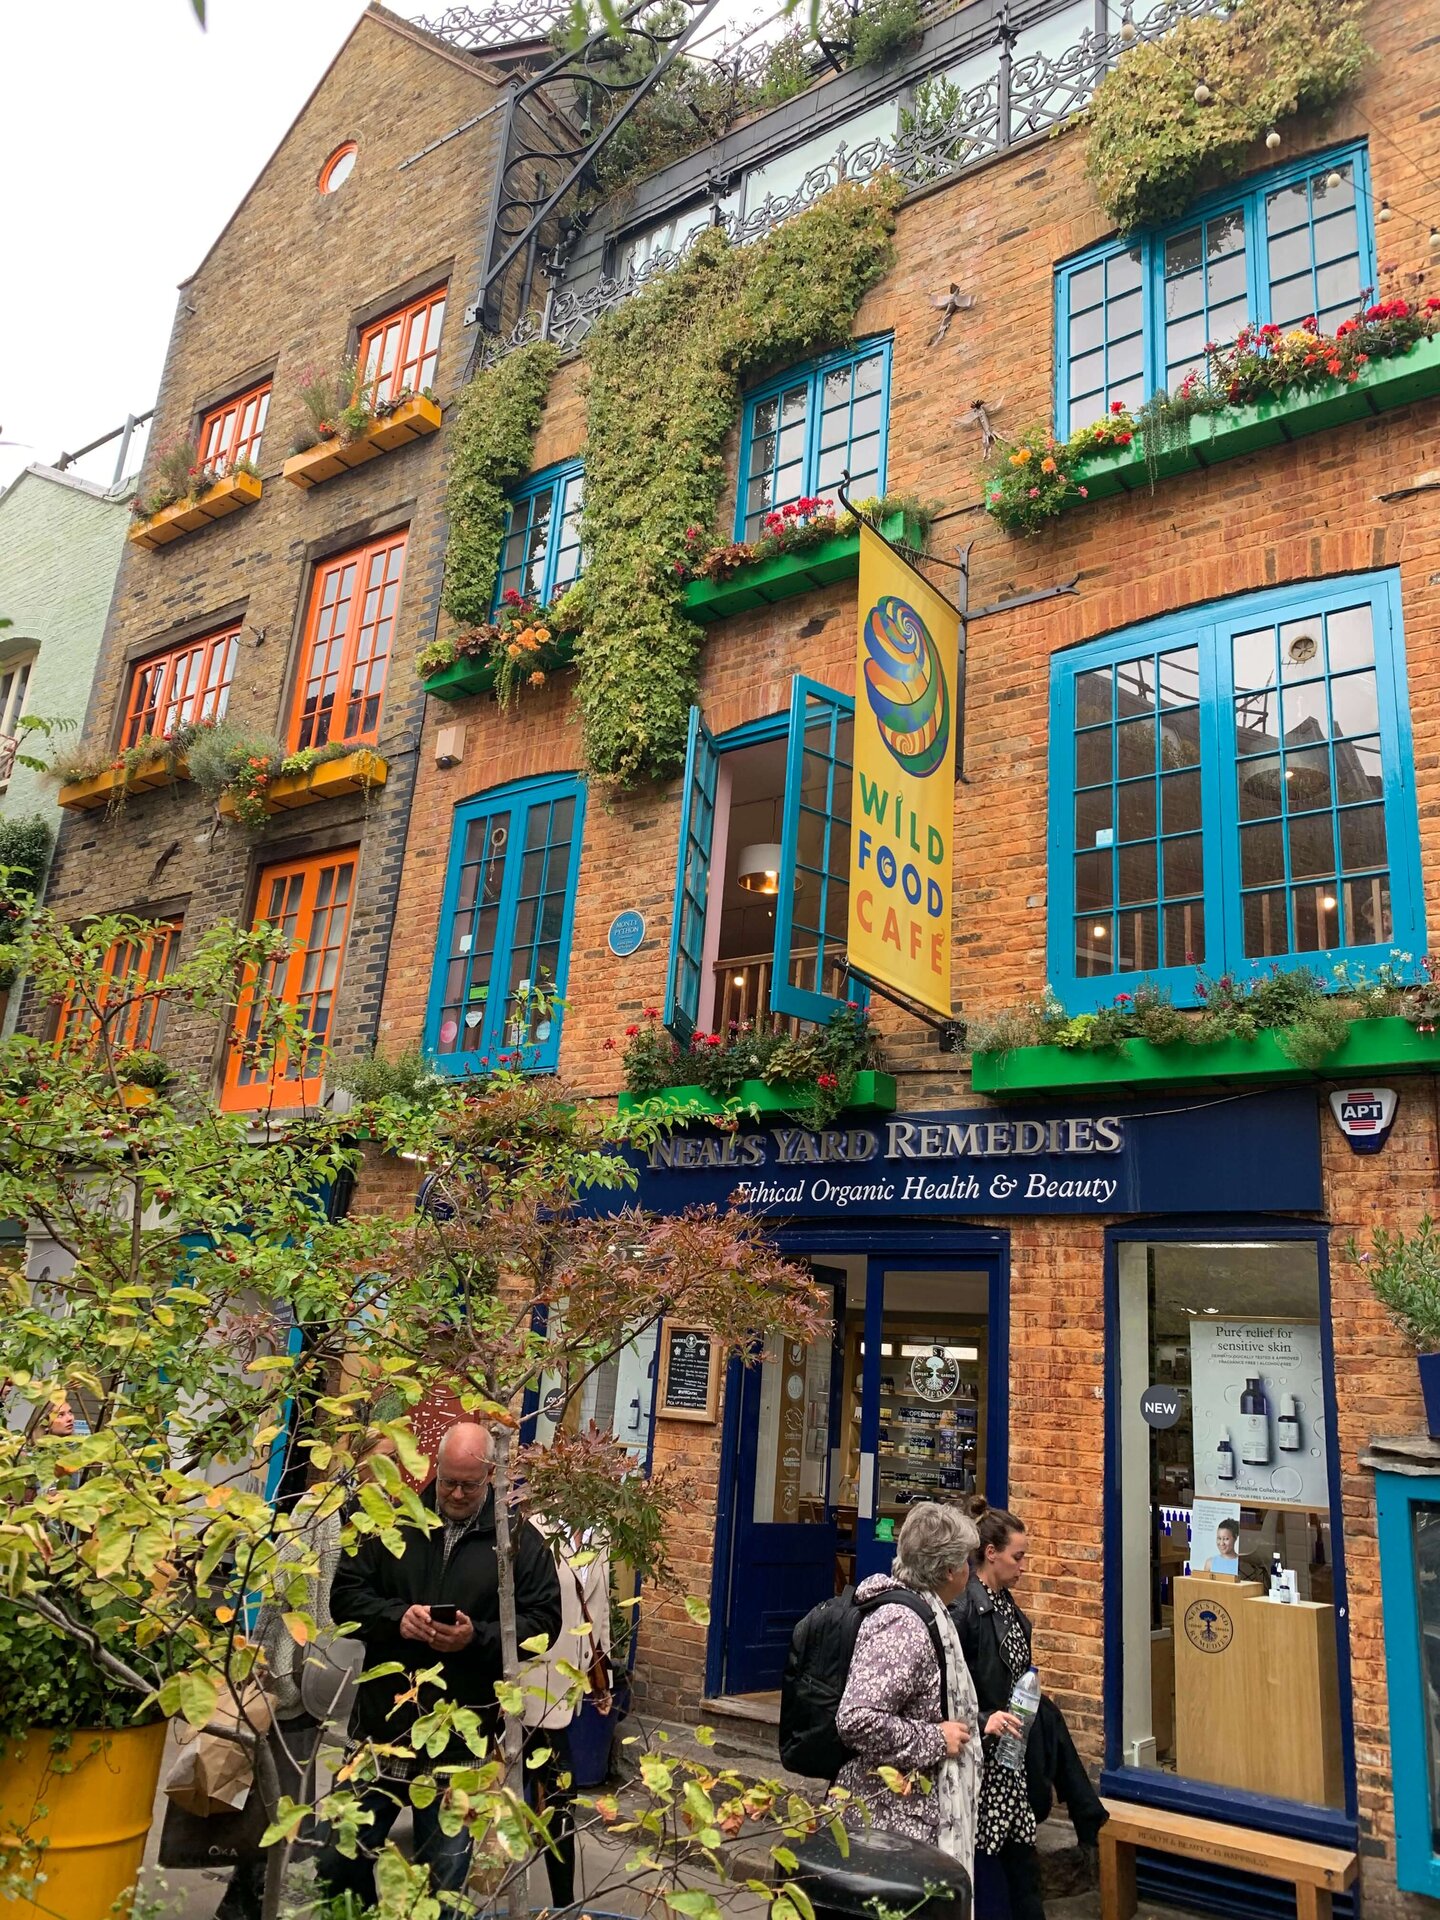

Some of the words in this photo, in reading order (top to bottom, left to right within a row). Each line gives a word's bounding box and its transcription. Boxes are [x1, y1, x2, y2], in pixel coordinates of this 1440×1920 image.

[859, 771, 944, 865] WILD
[858, 829, 943, 918] FOOD
[1343, 1104, 1381, 1119] APT
[646, 1133, 766, 1169] NEAL'S
[769, 1127, 878, 1163] YARD
[884, 1116, 1122, 1158] REMEDIES
[811, 1177, 895, 1206] Organic
[901, 1174, 980, 1201] Health
[989, 1173, 1018, 1199] &
[1024, 1173, 1117, 1203] Beauty
[1215, 1326, 1242, 1338] Pure
[1246, 1327, 1274, 1338] relief
[1277, 1327, 1294, 1339] for
[1217, 1340, 1265, 1352] sensitive
[1267, 1341, 1292, 1353] skin
[908, 1410, 936, 1419] OPENING
[1145, 1402, 1177, 1415] NEW
